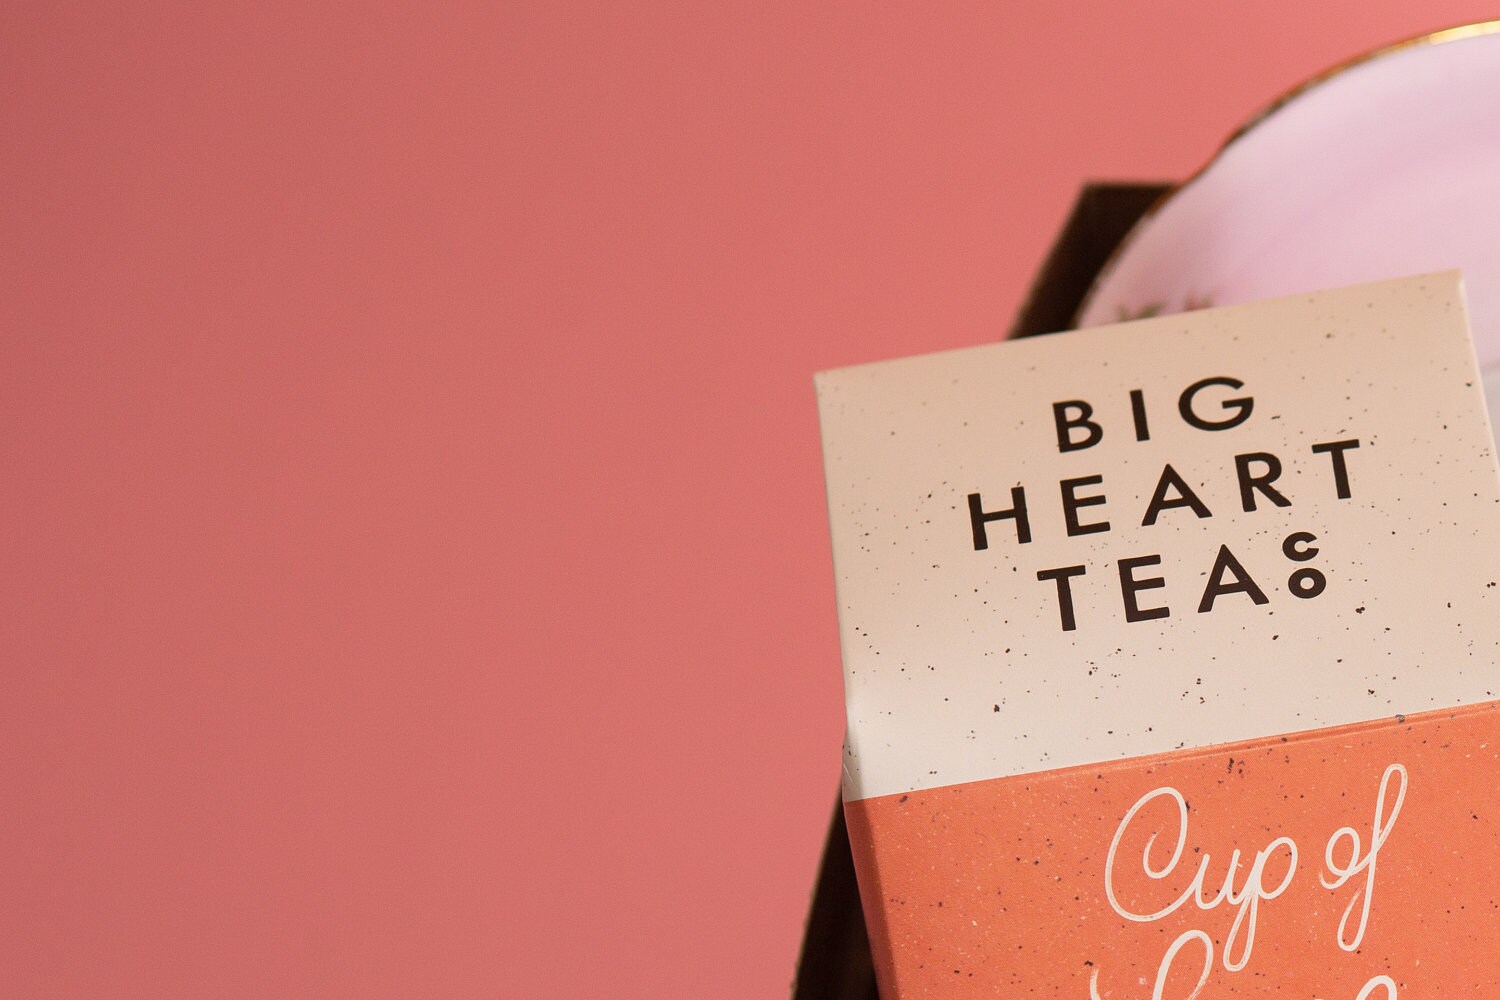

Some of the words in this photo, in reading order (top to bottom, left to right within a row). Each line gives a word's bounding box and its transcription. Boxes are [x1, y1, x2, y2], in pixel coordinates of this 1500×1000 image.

[1052, 377, 1254, 453] BIG
[967, 439, 1360, 551] HEART
[1037, 544, 1269, 631] TEA
[1105, 787, 1298, 971] Cup
[1319, 763, 1408, 951] of
